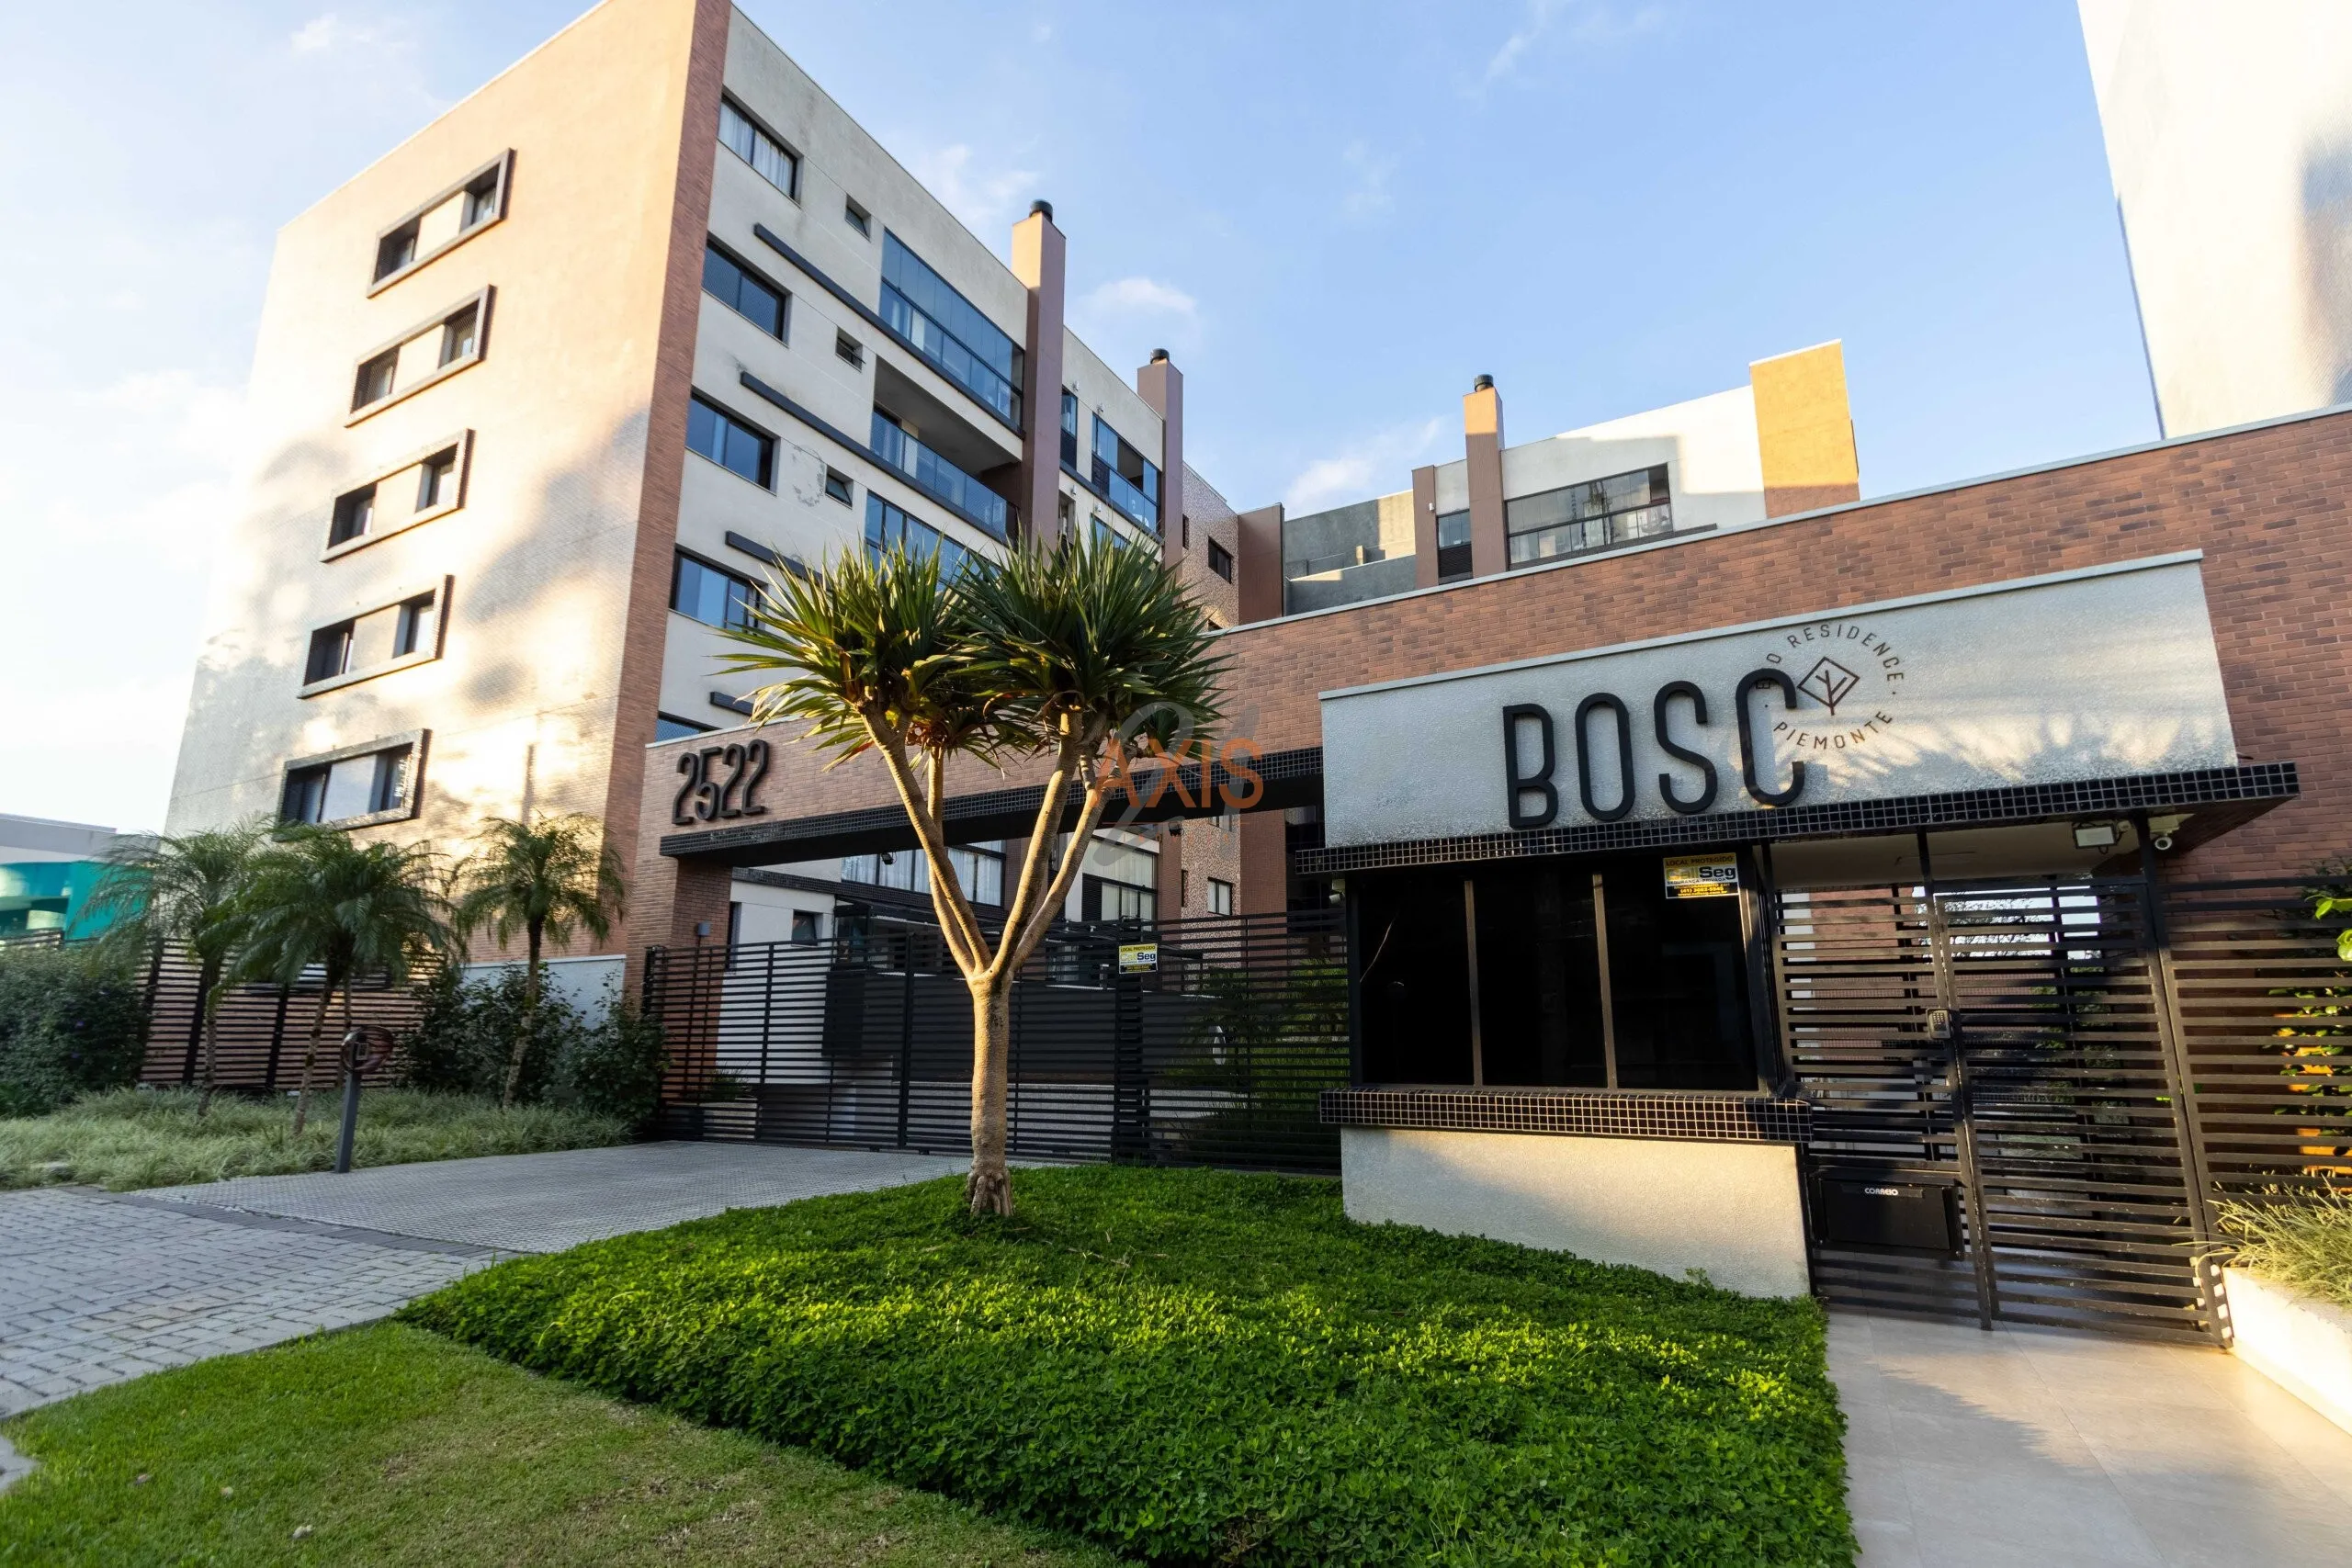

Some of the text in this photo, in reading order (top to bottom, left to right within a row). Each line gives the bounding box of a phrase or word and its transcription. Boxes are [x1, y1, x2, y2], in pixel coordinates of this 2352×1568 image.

[1787, 624, 1904, 682] RESIDENCE
[1773, 711, 1893, 750] PIEMONTE
[672, 739, 770, 827] 2522
[1864, 1188, 1899, 1196] CORREIO
